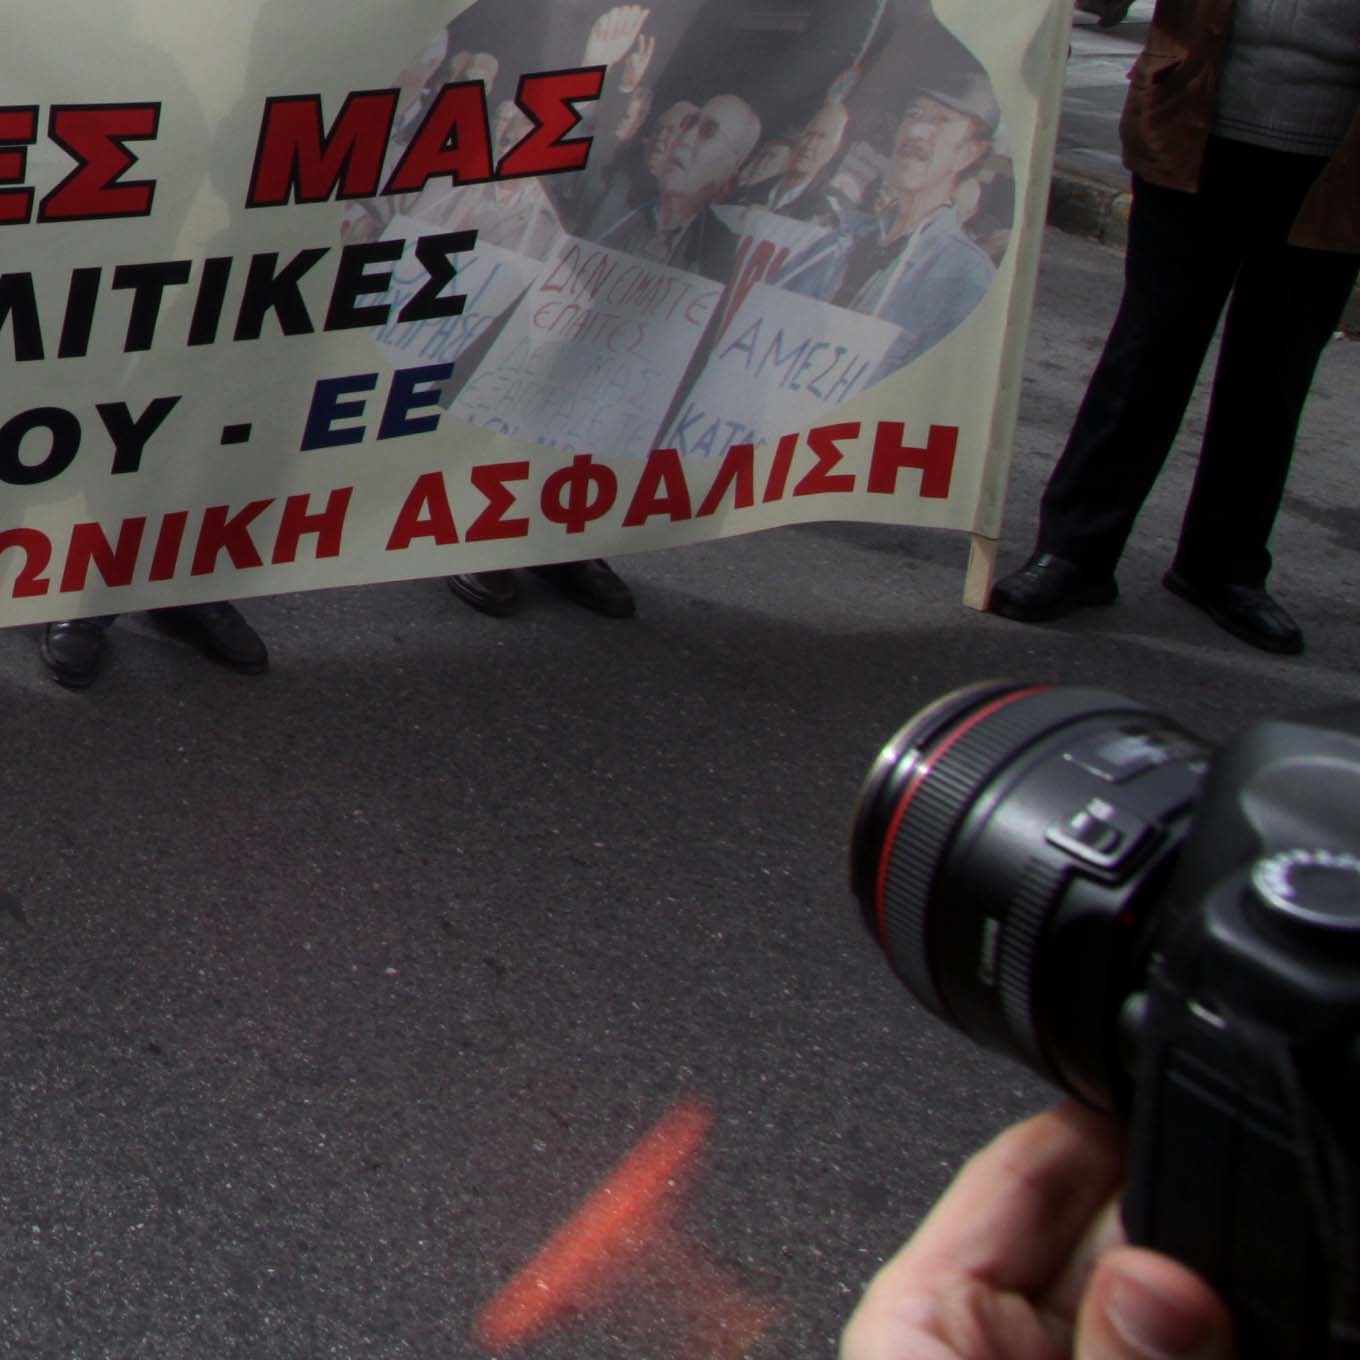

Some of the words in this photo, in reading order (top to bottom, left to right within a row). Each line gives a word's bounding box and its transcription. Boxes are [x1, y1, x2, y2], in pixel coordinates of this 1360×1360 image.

[245, 64, 607, 210] ΜΑΣ
[538, 242, 618, 303] ΔΕΝ
[719, 316, 871, 404] ΑΜΕΣΗ
[299, 362, 456, 453] ΕΕ
[384, 420, 960, 553] ΑΣΦΑΛΙΣΗ
